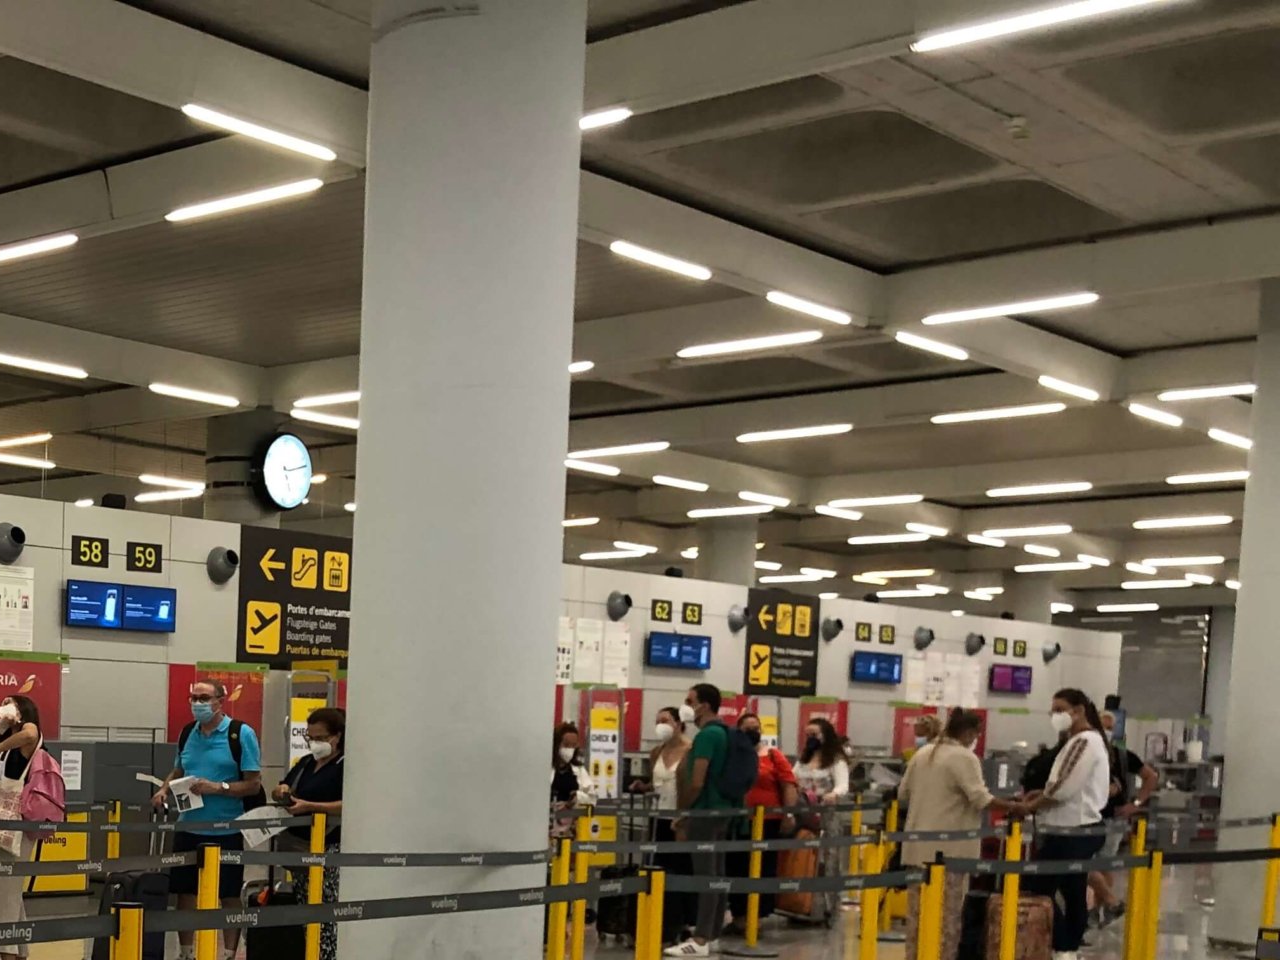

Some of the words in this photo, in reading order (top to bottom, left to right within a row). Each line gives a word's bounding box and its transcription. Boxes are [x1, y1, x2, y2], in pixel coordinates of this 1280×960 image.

[80, 540, 102, 563] 58
[134, 546, 156, 568] 59
[287, 603, 308, 615] Portes
[656, 602, 669, 619] 62
[686, 606, 699, 622] 63
[225, 909, 260, 925] vueling
[333, 903, 365, 918] vueling
